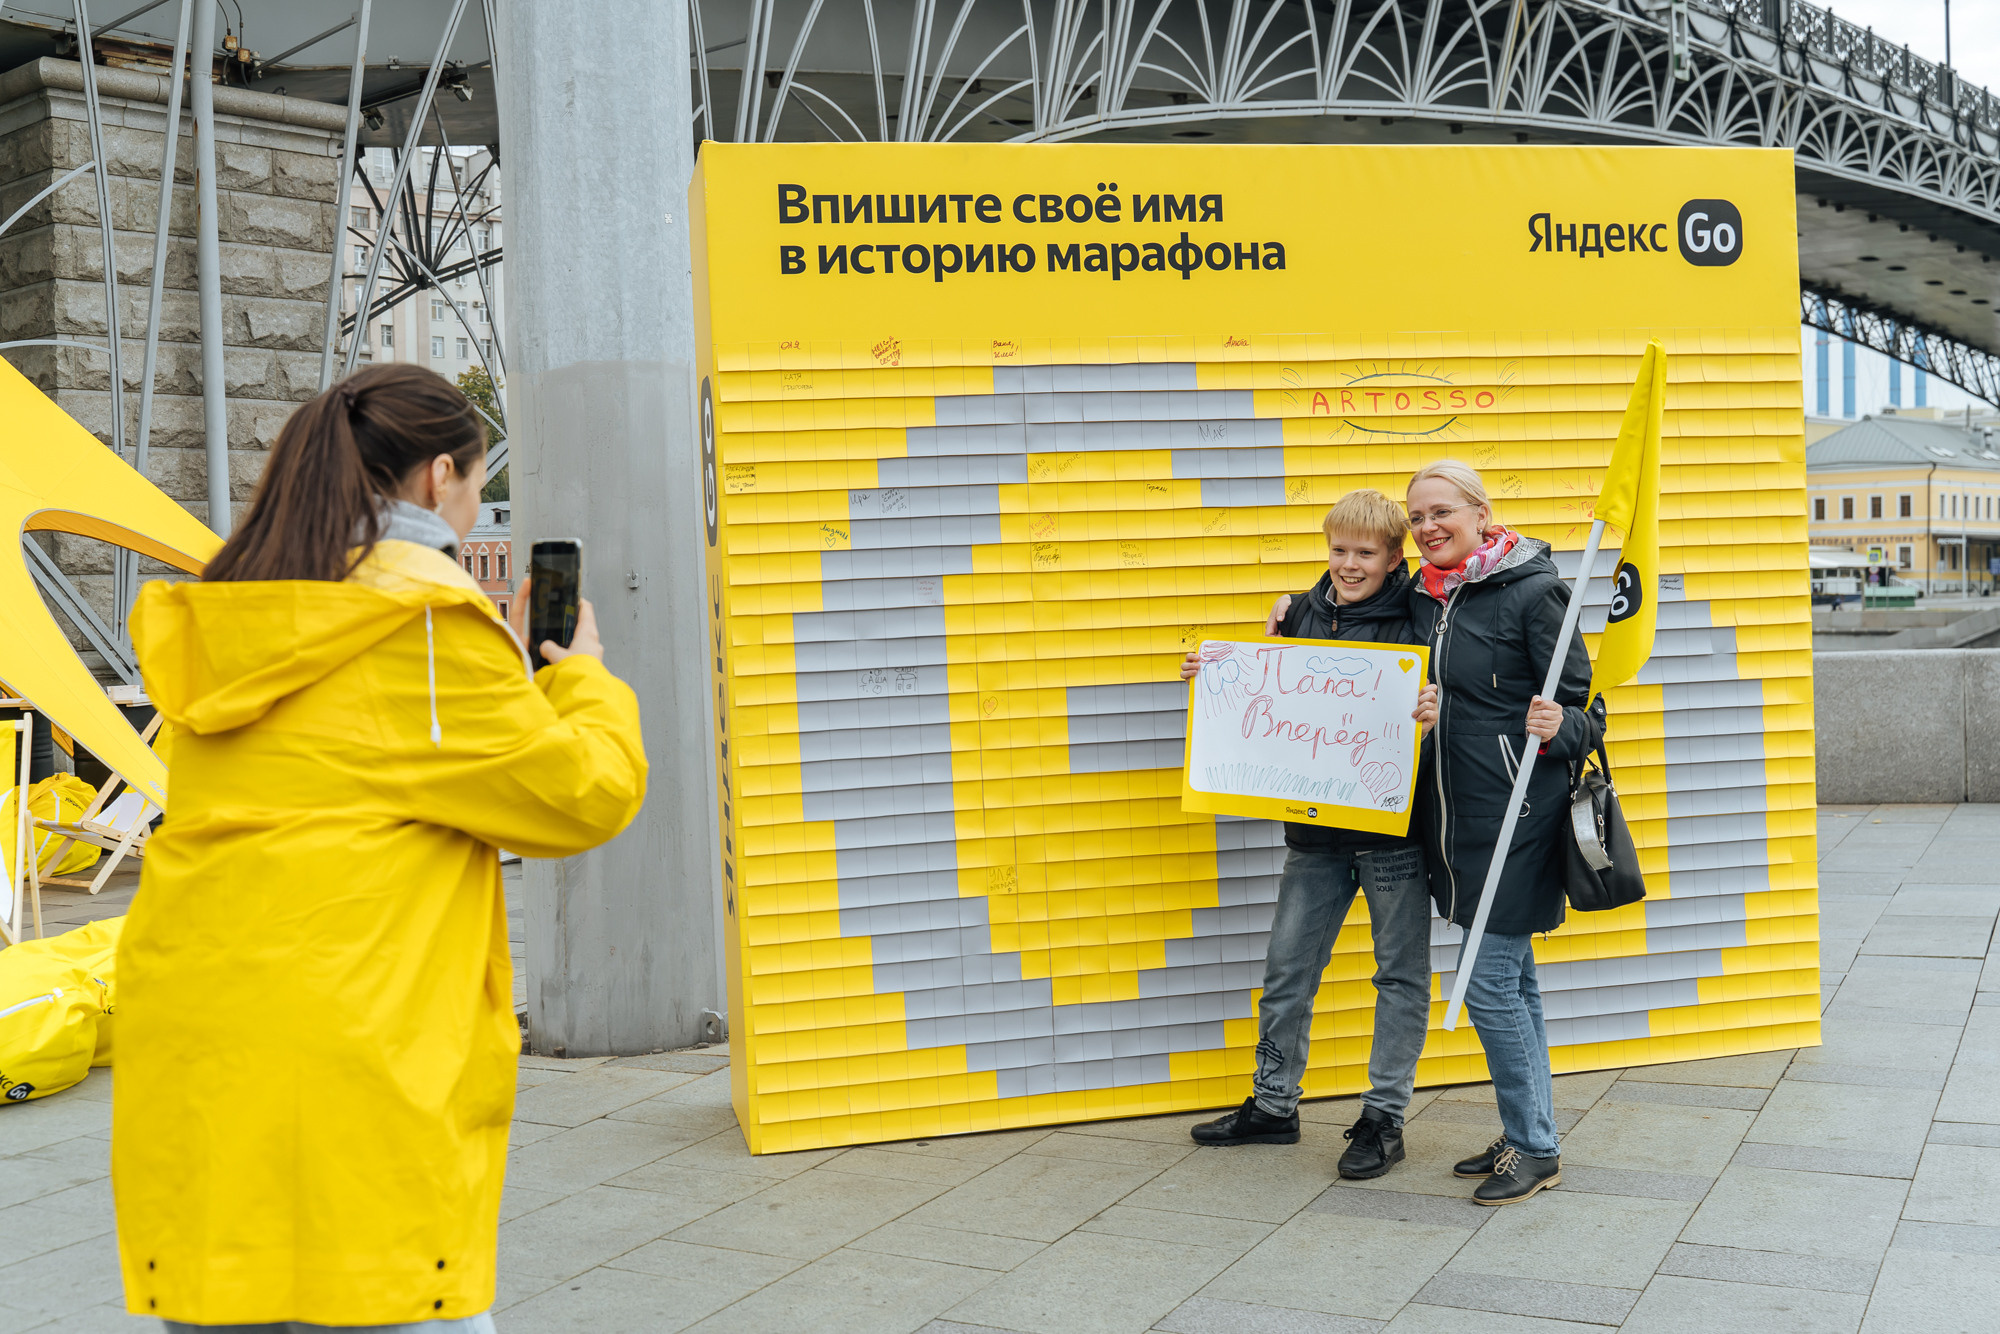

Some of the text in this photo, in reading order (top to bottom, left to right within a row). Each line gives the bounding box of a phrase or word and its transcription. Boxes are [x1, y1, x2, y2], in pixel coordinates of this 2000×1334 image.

[777, 182, 1224, 225] Впишите своё имя
[1528, 212, 1737, 258] Яндекс Go
[779, 232, 1287, 283] в историю марафона
[1312, 390, 1495, 415] ARTOSSO
[1285, 806, 1317, 817] Яндекс Go
